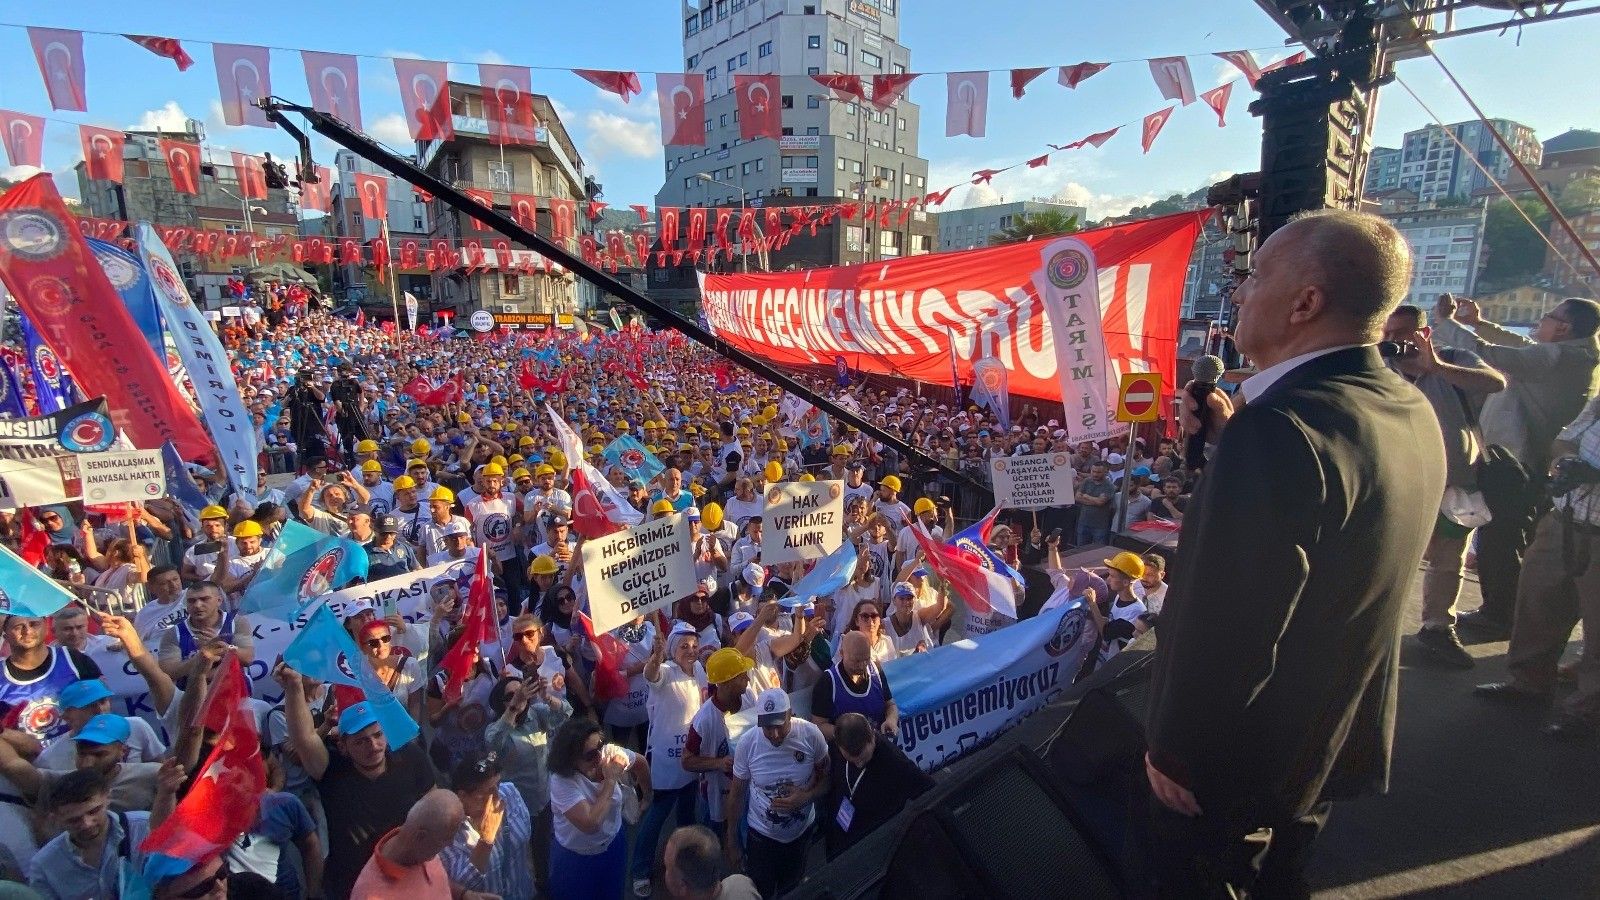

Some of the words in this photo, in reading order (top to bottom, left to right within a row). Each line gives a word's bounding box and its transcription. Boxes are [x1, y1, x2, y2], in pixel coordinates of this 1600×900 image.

[494, 314, 526, 323] TRABZON
[86, 457, 155, 470] SENDİKALAŞMAK
[1011, 457, 1048, 466] İNSANCA
[1005, 465, 1056, 475] YAŞAYACAK
[87, 474, 129, 484] ANAYASAL
[130, 471, 160, 481] HAKTIR
[1014, 482, 1051, 491] ÇALIŞMA
[1011, 489, 1055, 499] KOŞULLARI
[792, 494, 819, 510] HAK
[1013, 497, 1055, 505] İSTİYORUZ
[774, 511, 834, 531] VERİLMEZ
[601, 523, 675, 559] HİÇBİRİMİZ
[783, 531, 824, 549] ALINIR
[600, 541, 681, 580] HEPİMİZDEN
[622, 563, 667, 592] GÜÇLÜ
[620, 583, 675, 614] DEĞİLİZ.
